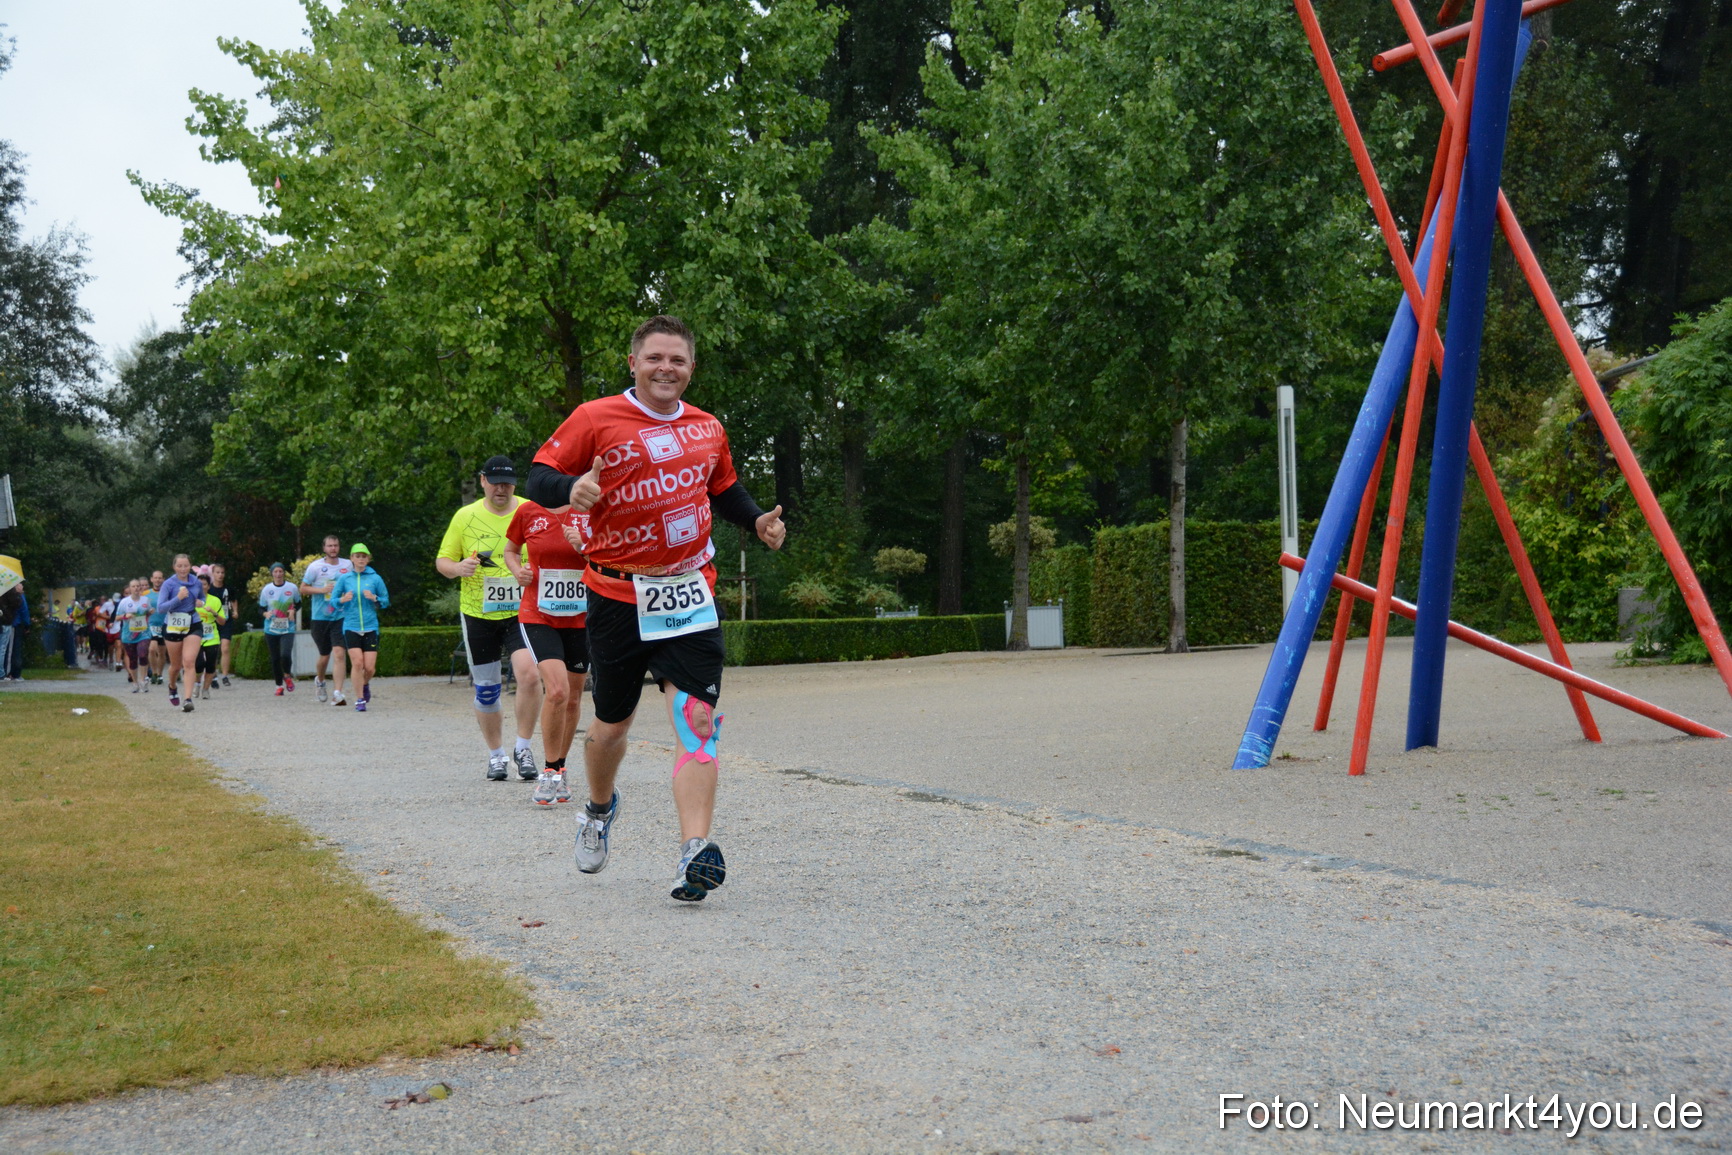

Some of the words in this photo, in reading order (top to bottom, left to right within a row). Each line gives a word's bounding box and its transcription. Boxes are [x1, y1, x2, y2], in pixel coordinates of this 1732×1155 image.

[642, 427, 671, 439] raumbox
[612, 461, 643, 478] outdoor
[641, 496, 676, 511] wohnen
[665, 507, 695, 522] raumbox
[487, 586, 522, 601] 2911
[544, 581, 585, 598] 2086
[645, 580, 705, 612] 2355
[496, 602, 515, 611] Alfred
[550, 602, 579, 611] Cornelia
[172, 617, 186, 627] 261
[665, 616, 692, 628] Claus
